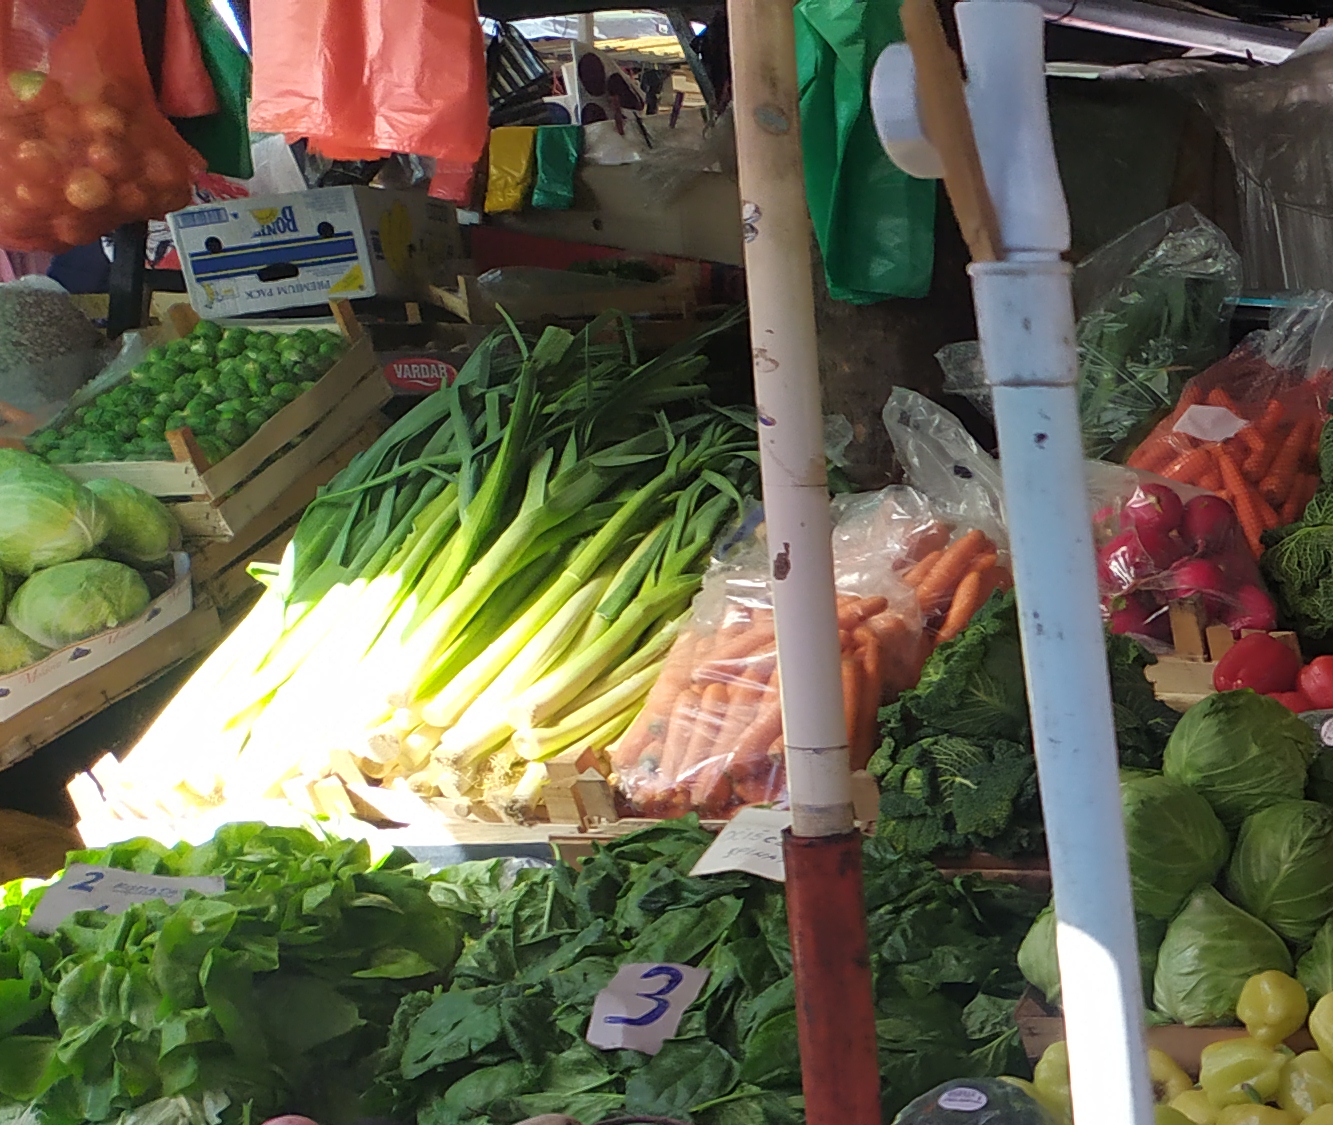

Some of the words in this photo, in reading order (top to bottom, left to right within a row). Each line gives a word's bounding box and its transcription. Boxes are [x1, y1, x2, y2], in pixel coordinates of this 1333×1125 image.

[244, 288, 274, 302] PACK
[278, 279, 332, 300] PREMIUM
[393, 363, 448, 379] VARDAR
[68, 872, 105, 892] 2
[605, 965, 684, 1027] 3
